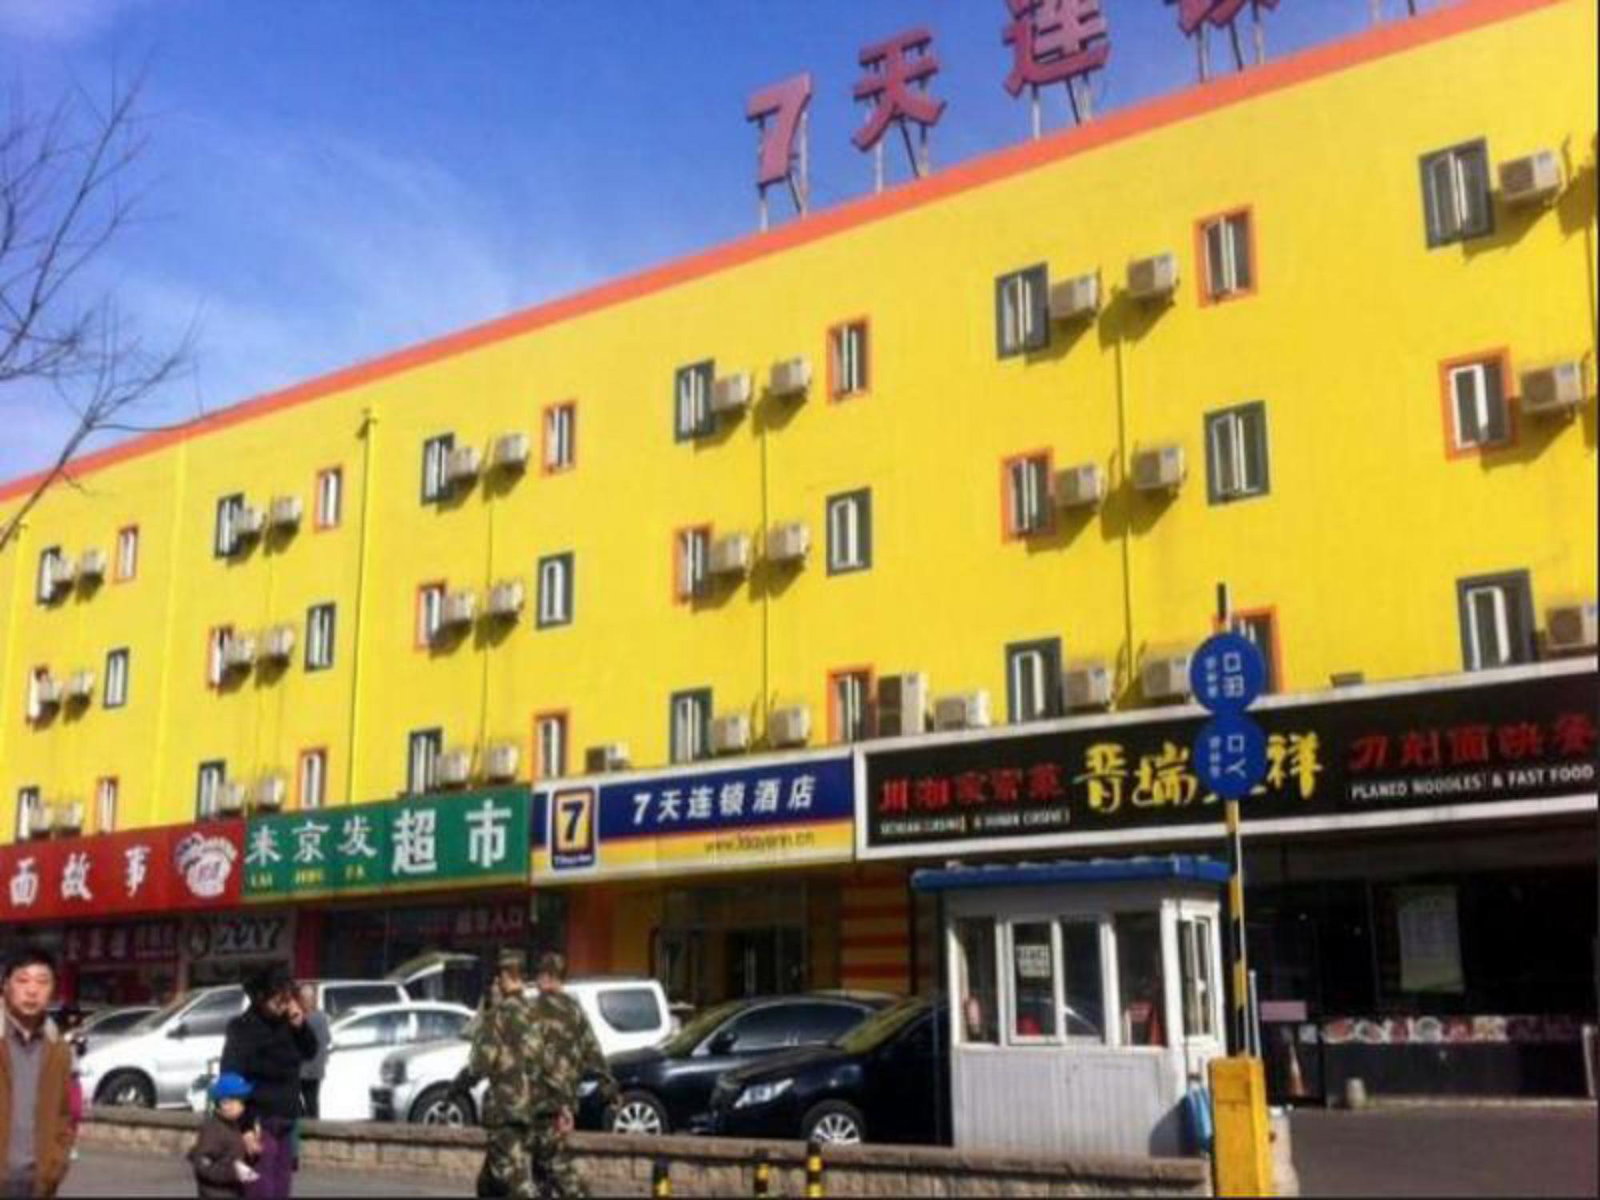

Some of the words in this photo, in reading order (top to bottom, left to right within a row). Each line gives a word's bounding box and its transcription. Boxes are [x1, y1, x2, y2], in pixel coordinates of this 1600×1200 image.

[746, 0, 1279, 189] 7天连
[1222, 651, 1246, 699] 出口
[1074, 732, 1322, 813] 晋瑞祥
[1225, 734, 1248, 779] 入口
[1508, 768, 1546, 786] FAST
[1550, 763, 1595, 782] FOOD
[561, 800, 585, 842] 7
[632, 774, 816, 825] 7天连锁酒店
